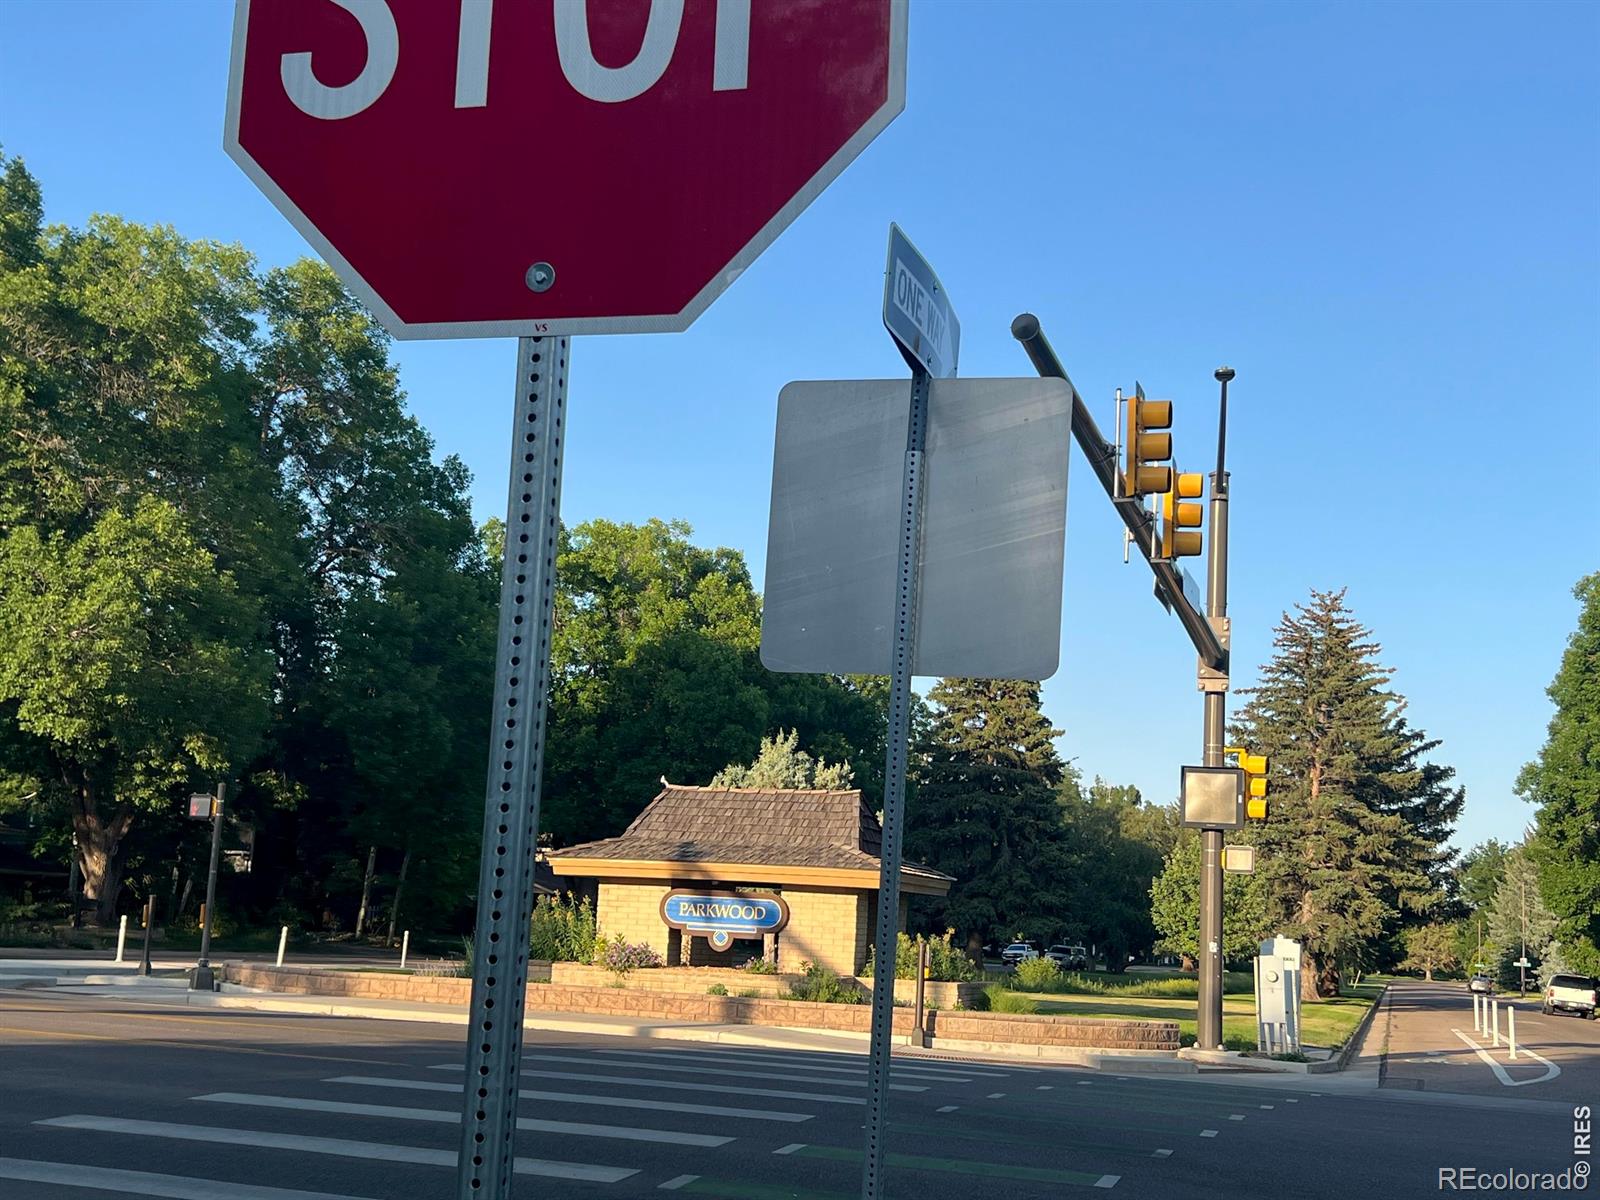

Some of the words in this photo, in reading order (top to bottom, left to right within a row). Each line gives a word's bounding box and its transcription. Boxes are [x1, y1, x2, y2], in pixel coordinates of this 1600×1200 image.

[897, 268, 924, 328] ONE
[926, 299, 946, 352] WAY
[535, 323, 548, 333] VS
[678, 902, 766, 920] PARKWOOD
